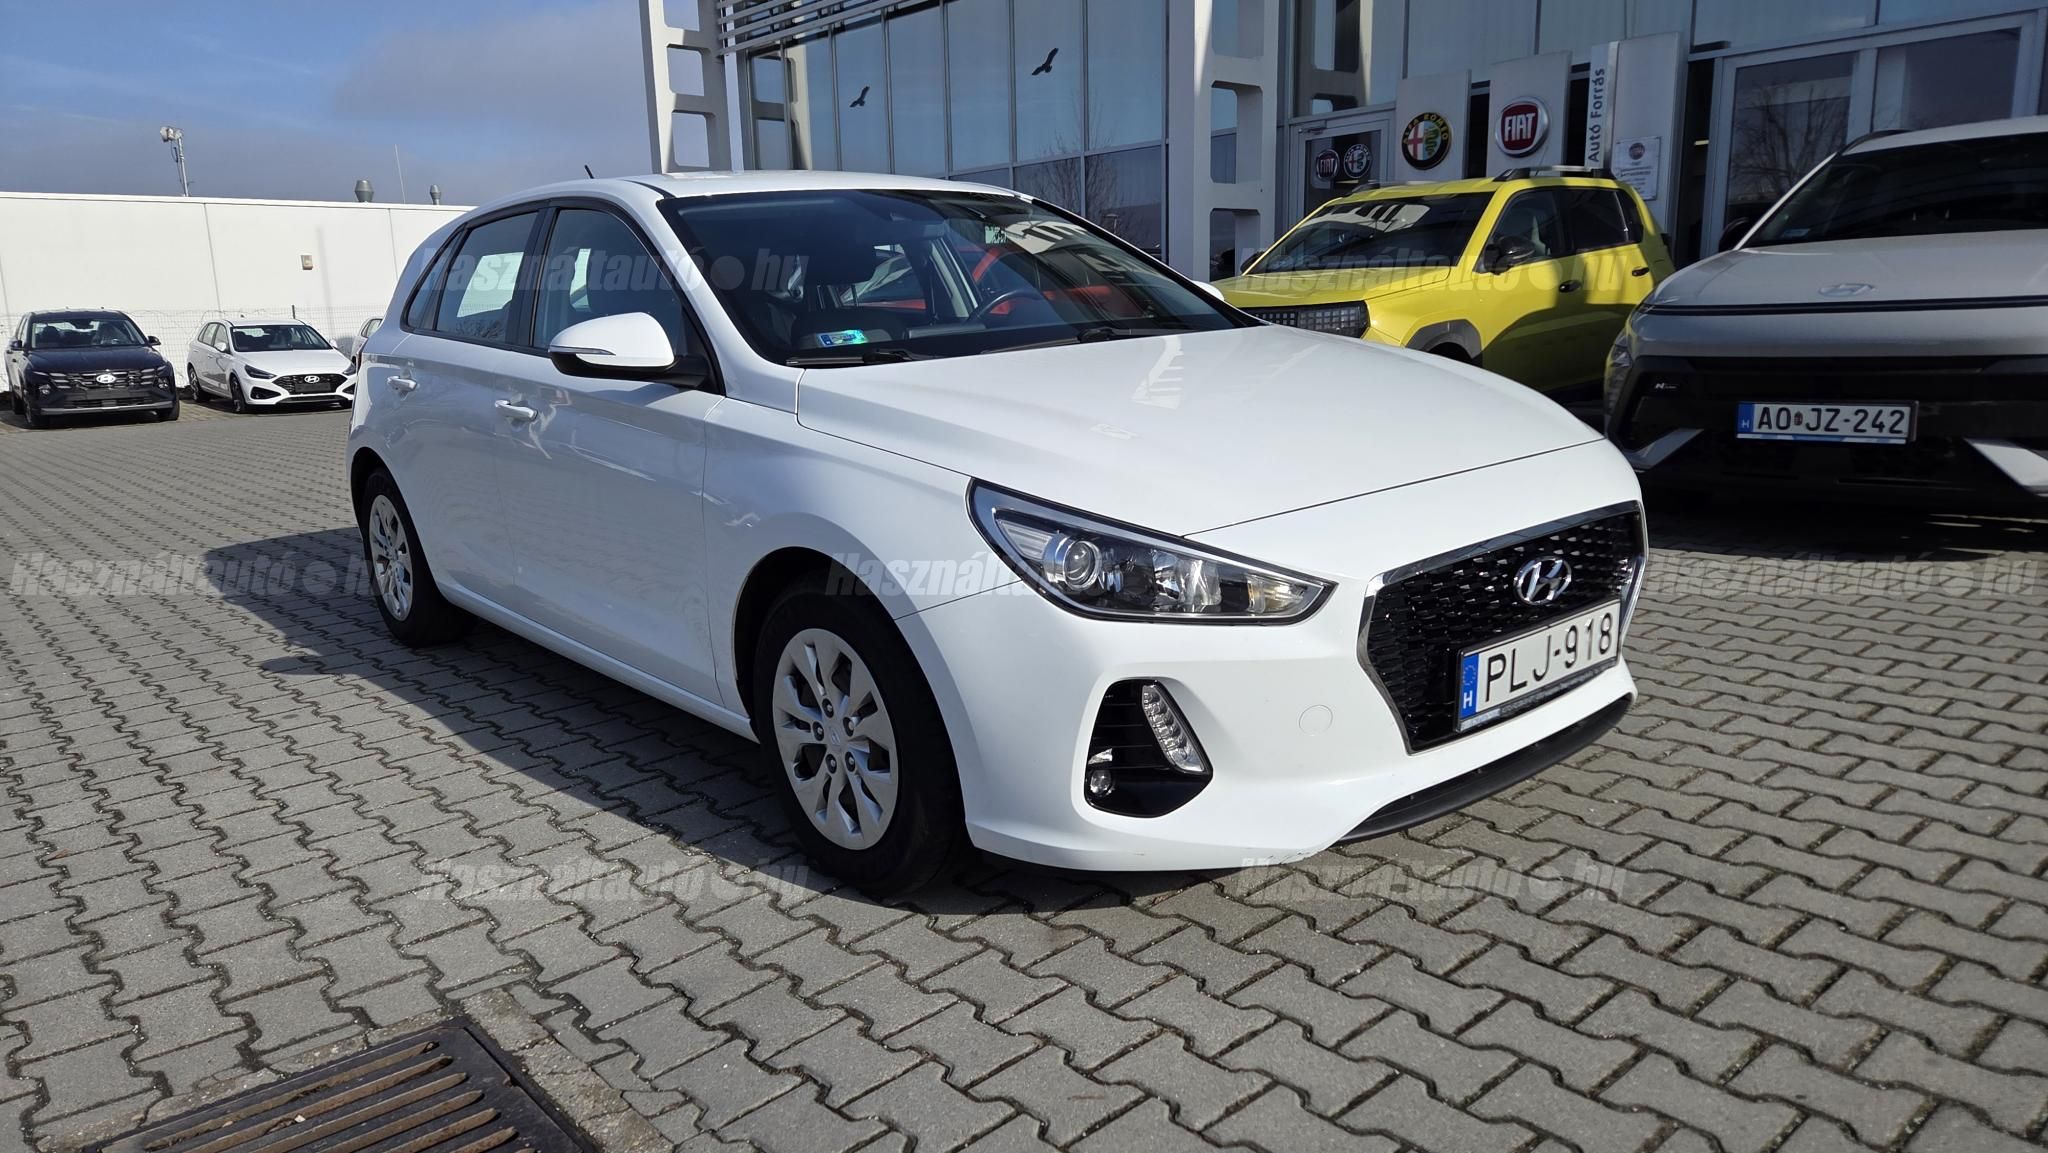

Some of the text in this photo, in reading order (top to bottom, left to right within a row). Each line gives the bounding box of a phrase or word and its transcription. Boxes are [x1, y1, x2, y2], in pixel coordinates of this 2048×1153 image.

[1504, 112, 1536, 142] FIAT
[1588, 68, 1605, 162] Autó Forrás
[1757, 406, 1791, 430] AO
[1805, 407, 1906, 434] JZ-242
[1462, 690, 1473, 709] H
[1484, 612, 1612, 703] PLJ-918
